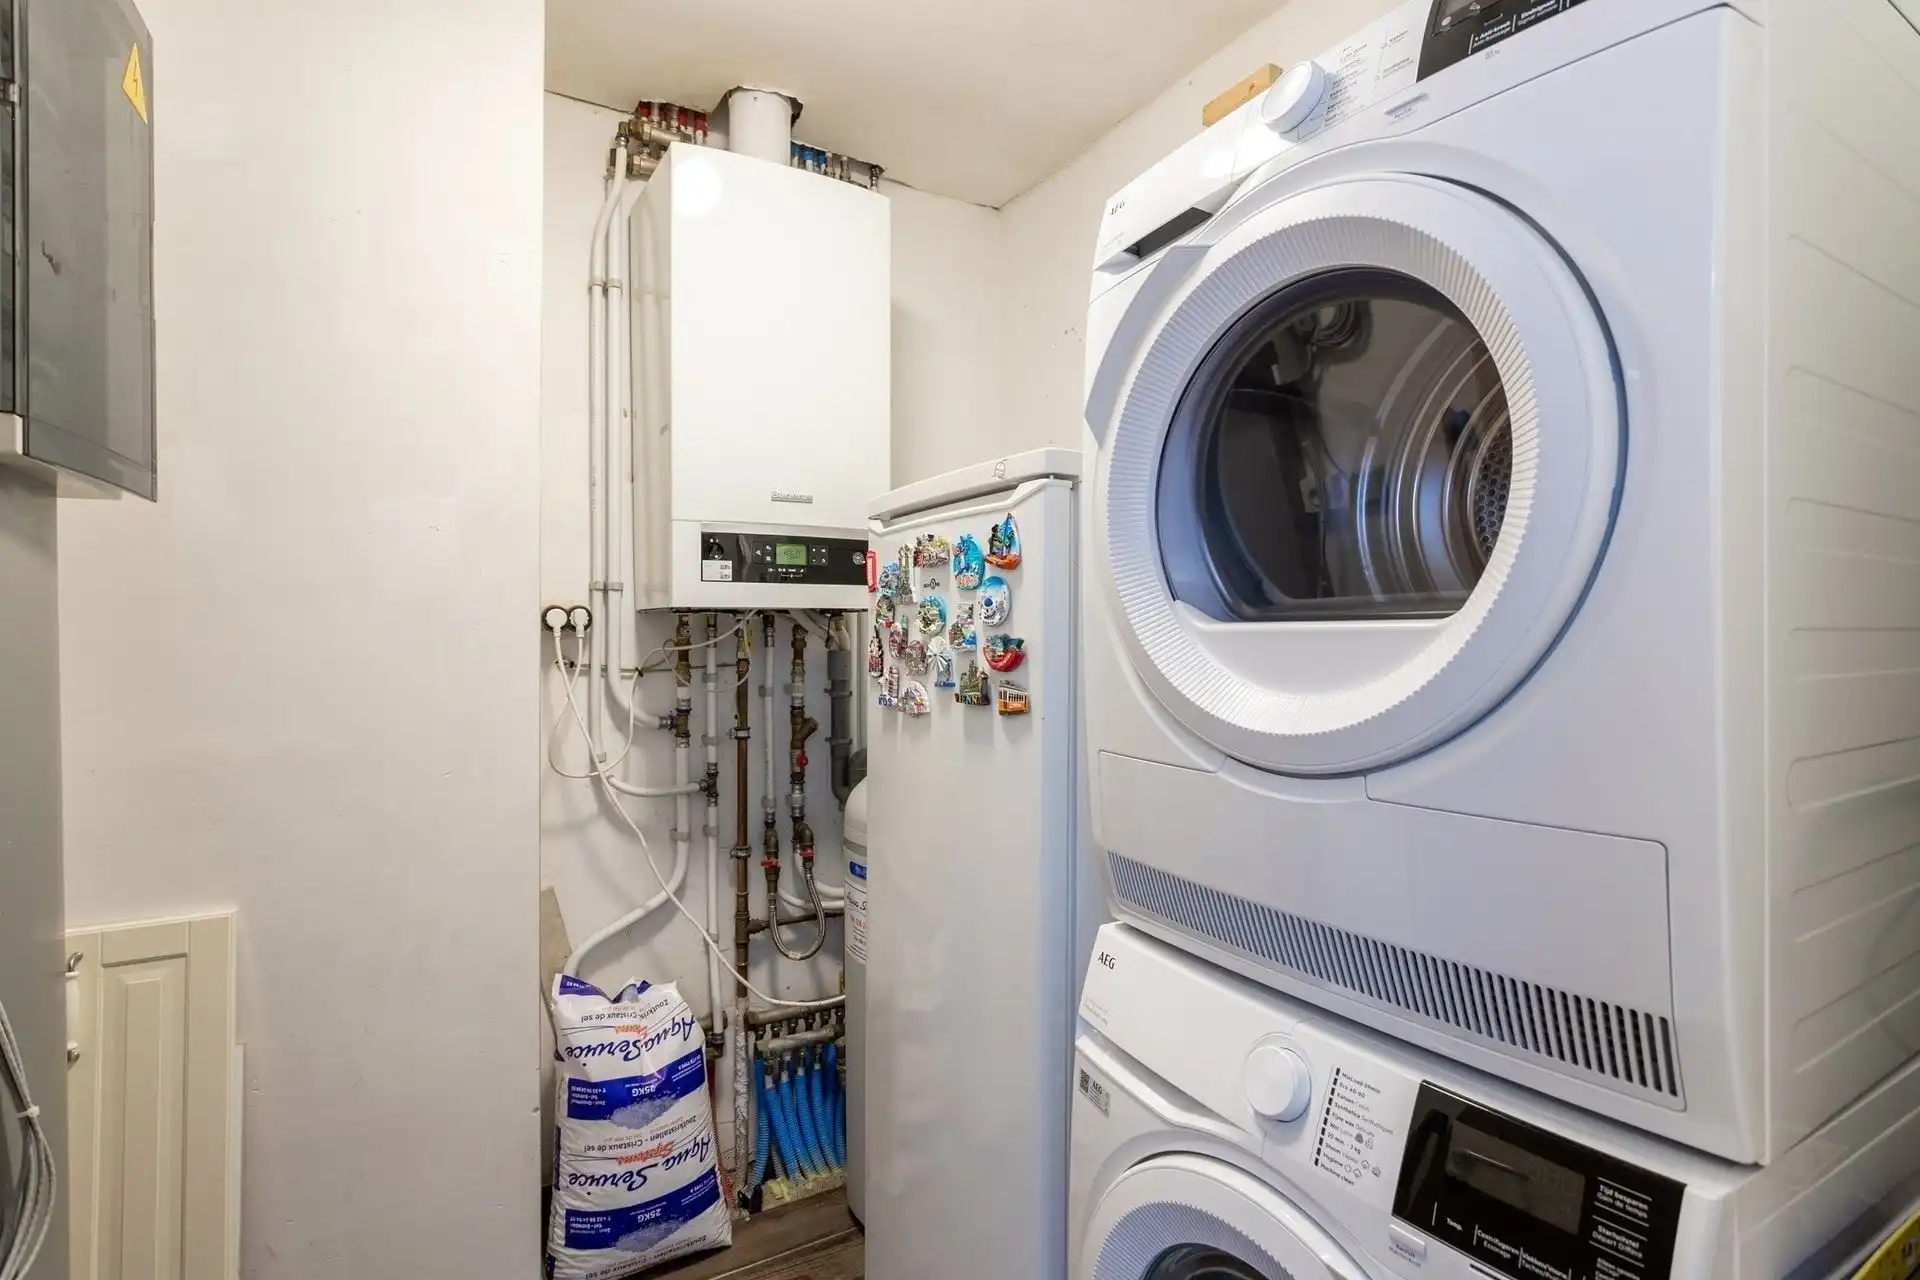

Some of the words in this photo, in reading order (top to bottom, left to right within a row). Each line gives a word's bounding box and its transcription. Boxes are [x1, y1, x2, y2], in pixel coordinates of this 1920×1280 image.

[1097, 951, 1117, 970] AEG
[581, 1015, 593, 1023] sel
[607, 1012, 637, 1020] Cristaux
[565, 1039, 642, 1066] Service
[632, 1085, 656, 1097] 25KG
[650, 1115, 697, 1141] Zoutkristallen
[584, 1145, 596, 1153] sel
[609, 1138, 643, 1150] Cristaux
[662, 1133, 711, 1171] Aqua
[568, 1162, 659, 1196] Service
[638, 1208, 662, 1223] 25KG
[600, 1267, 611, 1276] de
